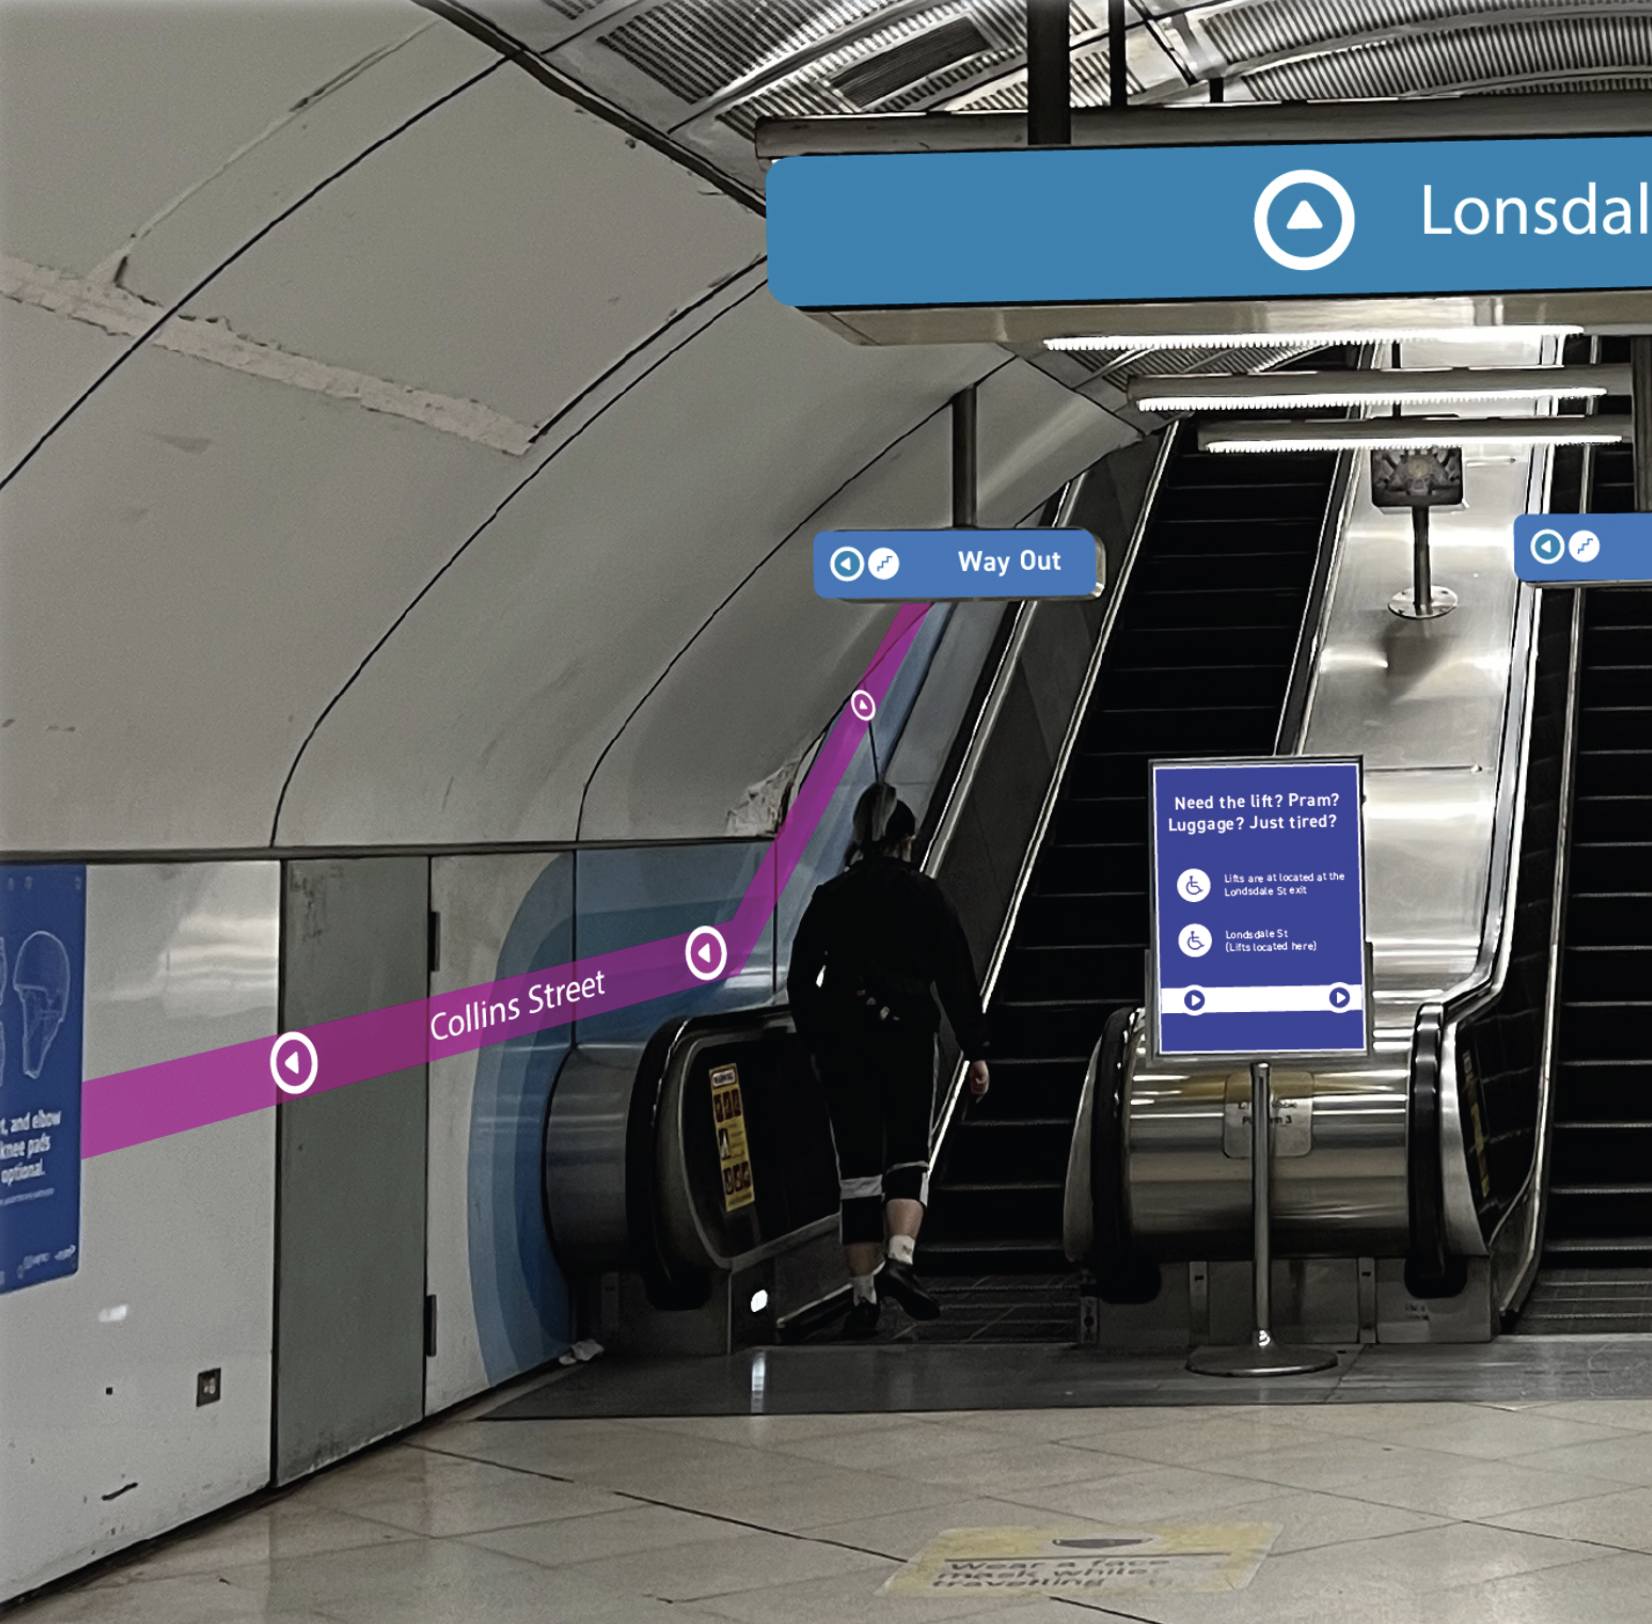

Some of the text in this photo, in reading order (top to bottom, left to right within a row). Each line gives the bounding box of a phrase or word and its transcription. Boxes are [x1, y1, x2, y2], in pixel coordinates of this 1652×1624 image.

[958, 549, 1061, 577] Way Out
[1175, 793, 1339, 810] Need the lift? Pram?
[1168, 814, 1337, 835] Luggage? Just tired?
[1224, 872, 1345, 883] Lifts are at located at the
[1276, 887, 1287, 895] St
[1289, 886, 1307, 895] exit
[1276, 929, 1289, 938] St
[1225, 940, 1317, 952] (Lifts located here)
[430, 971, 605, 1040] Collins Street
[10, 1111, 31, 1133] and
[31, 1109, 62, 1129] elbow
[27, 1132, 51, 1159] pads
[951, 1561, 1045, 1570] Wear
